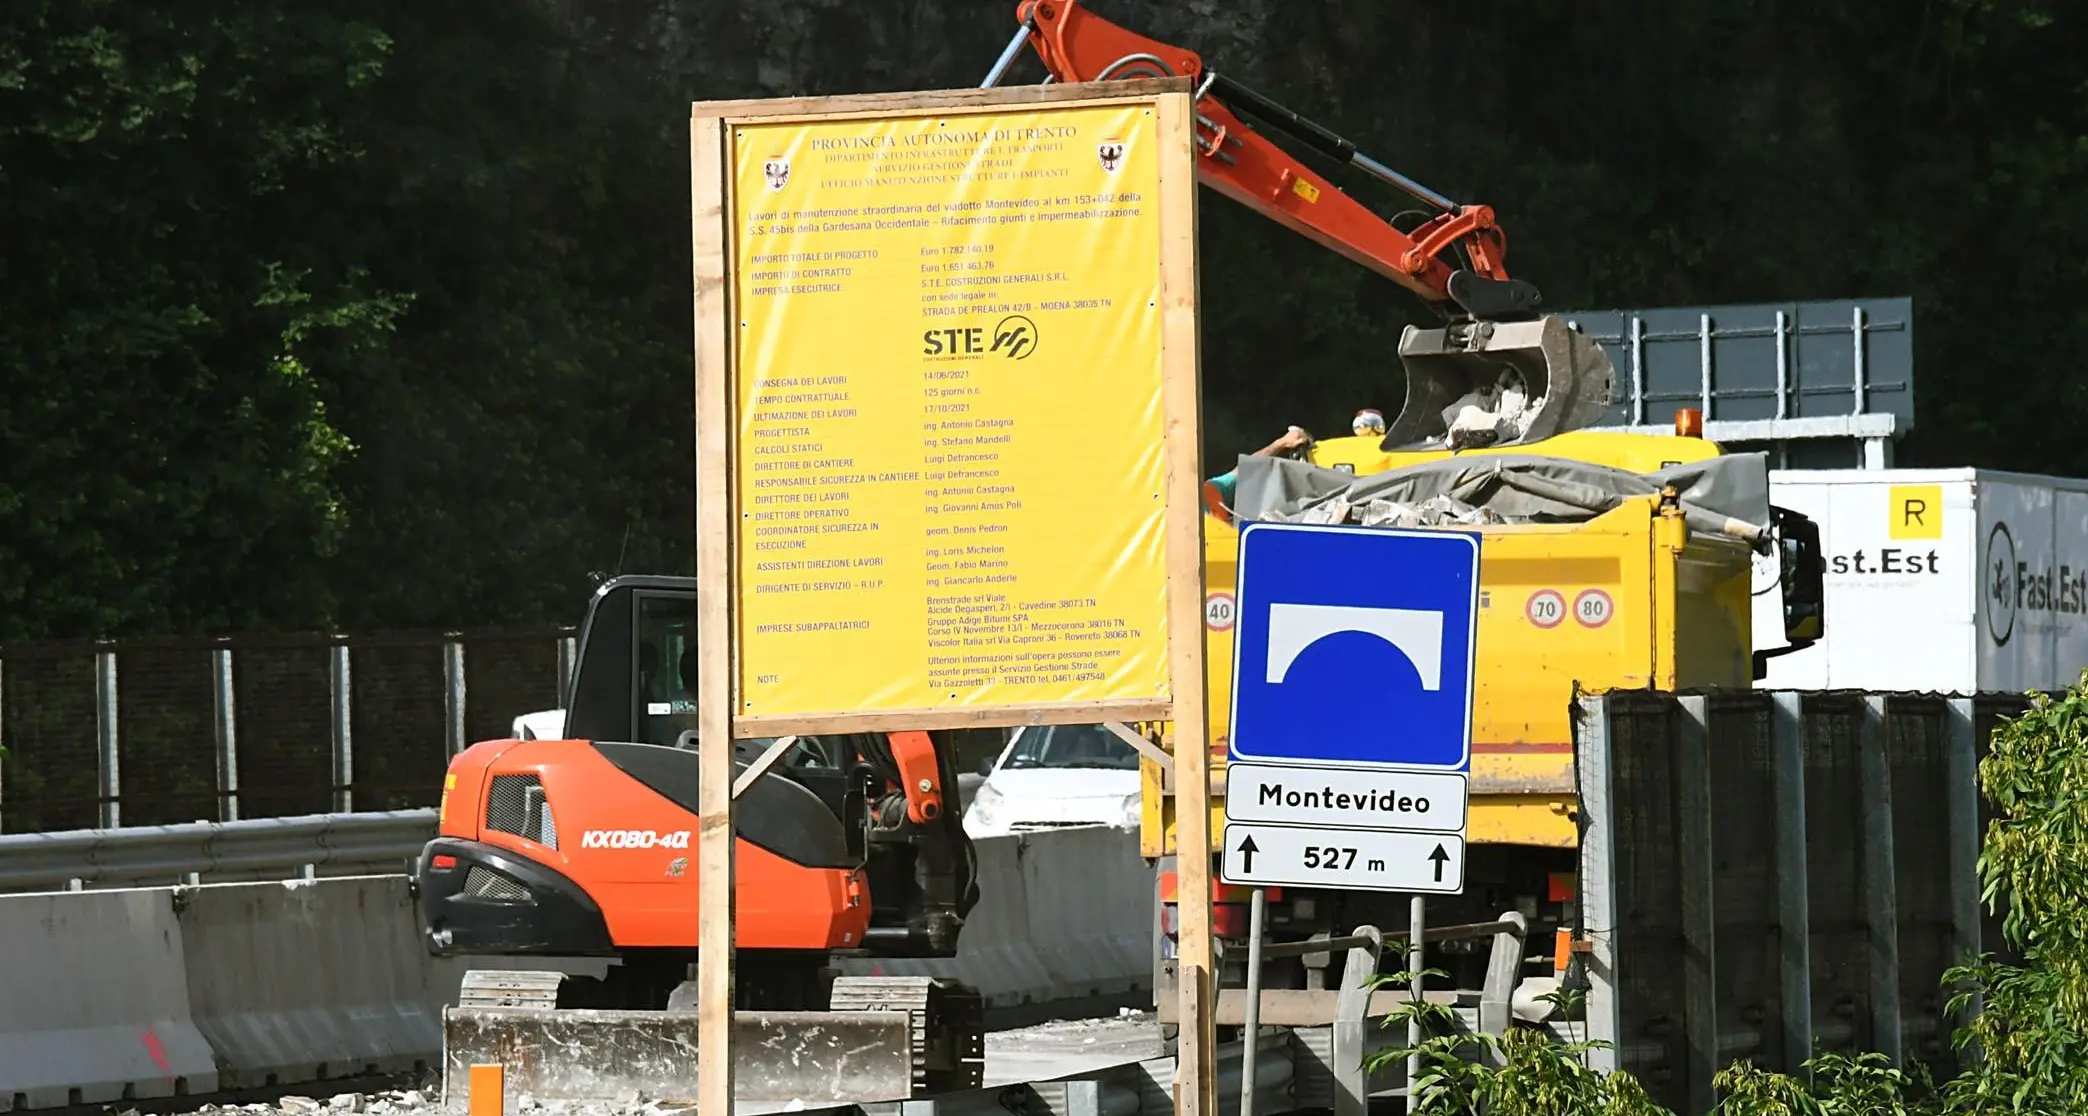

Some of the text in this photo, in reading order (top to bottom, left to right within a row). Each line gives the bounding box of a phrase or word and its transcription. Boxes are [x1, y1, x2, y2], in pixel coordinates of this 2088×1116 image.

[812, 126, 1076, 150] PROVINCIA AUTONOMA DI TRENTO
[780, 210, 790, 219] di
[793, 206, 859, 218] manutenzione
[862, 203, 922, 215] straordinaria
[926, 202, 940, 212] del
[944, 200, 981, 211] viadotto
[986, 197, 1039, 209] Montevideo
[1043, 197, 1052, 206] al
[1055, 196, 1070, 205] km
[1118, 192, 1141, 202] della
[769, 212, 1026, 234] 45bis della Gardesana Occidentale Rifacimento giunti
[751, 249, 878, 264] IMPORTO TOTALE DI PROGETTO
[920, 247, 939, 256] Euro
[751, 267, 851, 280] IMPORTO DI CONTRATTO
[920, 263, 940, 272] Euro
[945, 273, 1044, 286] COSTRUZIONI GENERALI
[791, 283, 841, 293] ESECUTRICE
[922, 300, 1070, 316] STRADA DE PREALON 42/B MOENA
[923, 327, 983, 355] STE
[800, 375, 847, 386] DEI LAVORI
[923, 370, 969, 380] 14/06/2021
[785, 392, 849, 403] CONTRATTUALE
[924, 387, 965, 397] 125 giorni
[924, 403, 970, 413] 17/10/2021
[753, 408, 857, 422] ULTIMAZIONE DEI LAVORI
[940, 417, 1014, 429] Antonio Castagna
[754, 427, 810, 438] PROGETTISTA
[941, 434, 1011, 446] Stefano Mandelli
[754, 443, 823, 455] CALCOLI STATICI
[924, 451, 999, 464] Luigi Defrancesco
[754, 458, 855, 471] DIRETTORE DI CANTIERE
[754, 471, 920, 488] RESPONSABILE SICUREZZA IN CANTIERE
[924, 468, 999, 481] Luigi Defrancesco
[942, 484, 1015, 496] Antonio Castagna
[755, 491, 849, 504] DIRETTORE DEI LAVORI
[942, 500, 1022, 512] Giovanni Amos Poli
[755, 508, 849, 521] DIRETTORE OPERATIVO
[1904, 499, 1926, 527] R
[755, 521, 879, 536] COORDINATORE SICUREZZA IN
[953, 523, 1008, 534] Denis Pedron
[755, 539, 807, 550] ESECUZIONE
[943, 544, 1004, 556] Loris Michelon
[756, 557, 883, 571] ASSISTENTI DIREZIONE LAVORI
[954, 558, 1008, 569] Fabio Marino
[1832, 549, 1940, 574] st.Est
[943, 573, 1017, 585] Giancarlo Anderle
[756, 580, 851, 594] DIRIGENTE DI SERVIZIO
[2016, 561, 2087, 616] Fast.Est
[927, 593, 1006, 605] Brenstrade srl Viale
[927, 598, 1096, 614] Alcide Cavedine TN
[1209, 604, 1230, 619] 40
[1537, 602, 1556, 617] 70
[1583, 600, 1604, 616] 80
[927, 613, 1029, 627] Gruppo Adige Bitumi SPA
[927, 618, 1125, 635] Corso IV Novembre Mezzocorona TN
[756, 620, 870, 634] IMPRESE SUBAPPALTATRICI
[927, 629, 1141, 647] Viscolor Italia srl Via Caproni Rovereto TN
[928, 649, 1121, 665] Ulteriori informazioni sull'opera possono essere
[928, 660, 1098, 677] assunte presso il Servizio Gestione Strade
[757, 674, 779, 684] NOTE
[928, 679, 942, 688] Via
[943, 677, 984, 688] Gazzoletti
[1003, 675, 1035, 684] TRENTO
[1259, 783, 1430, 814] Montevideo
[1303, 845, 1386, 872] 527 m
